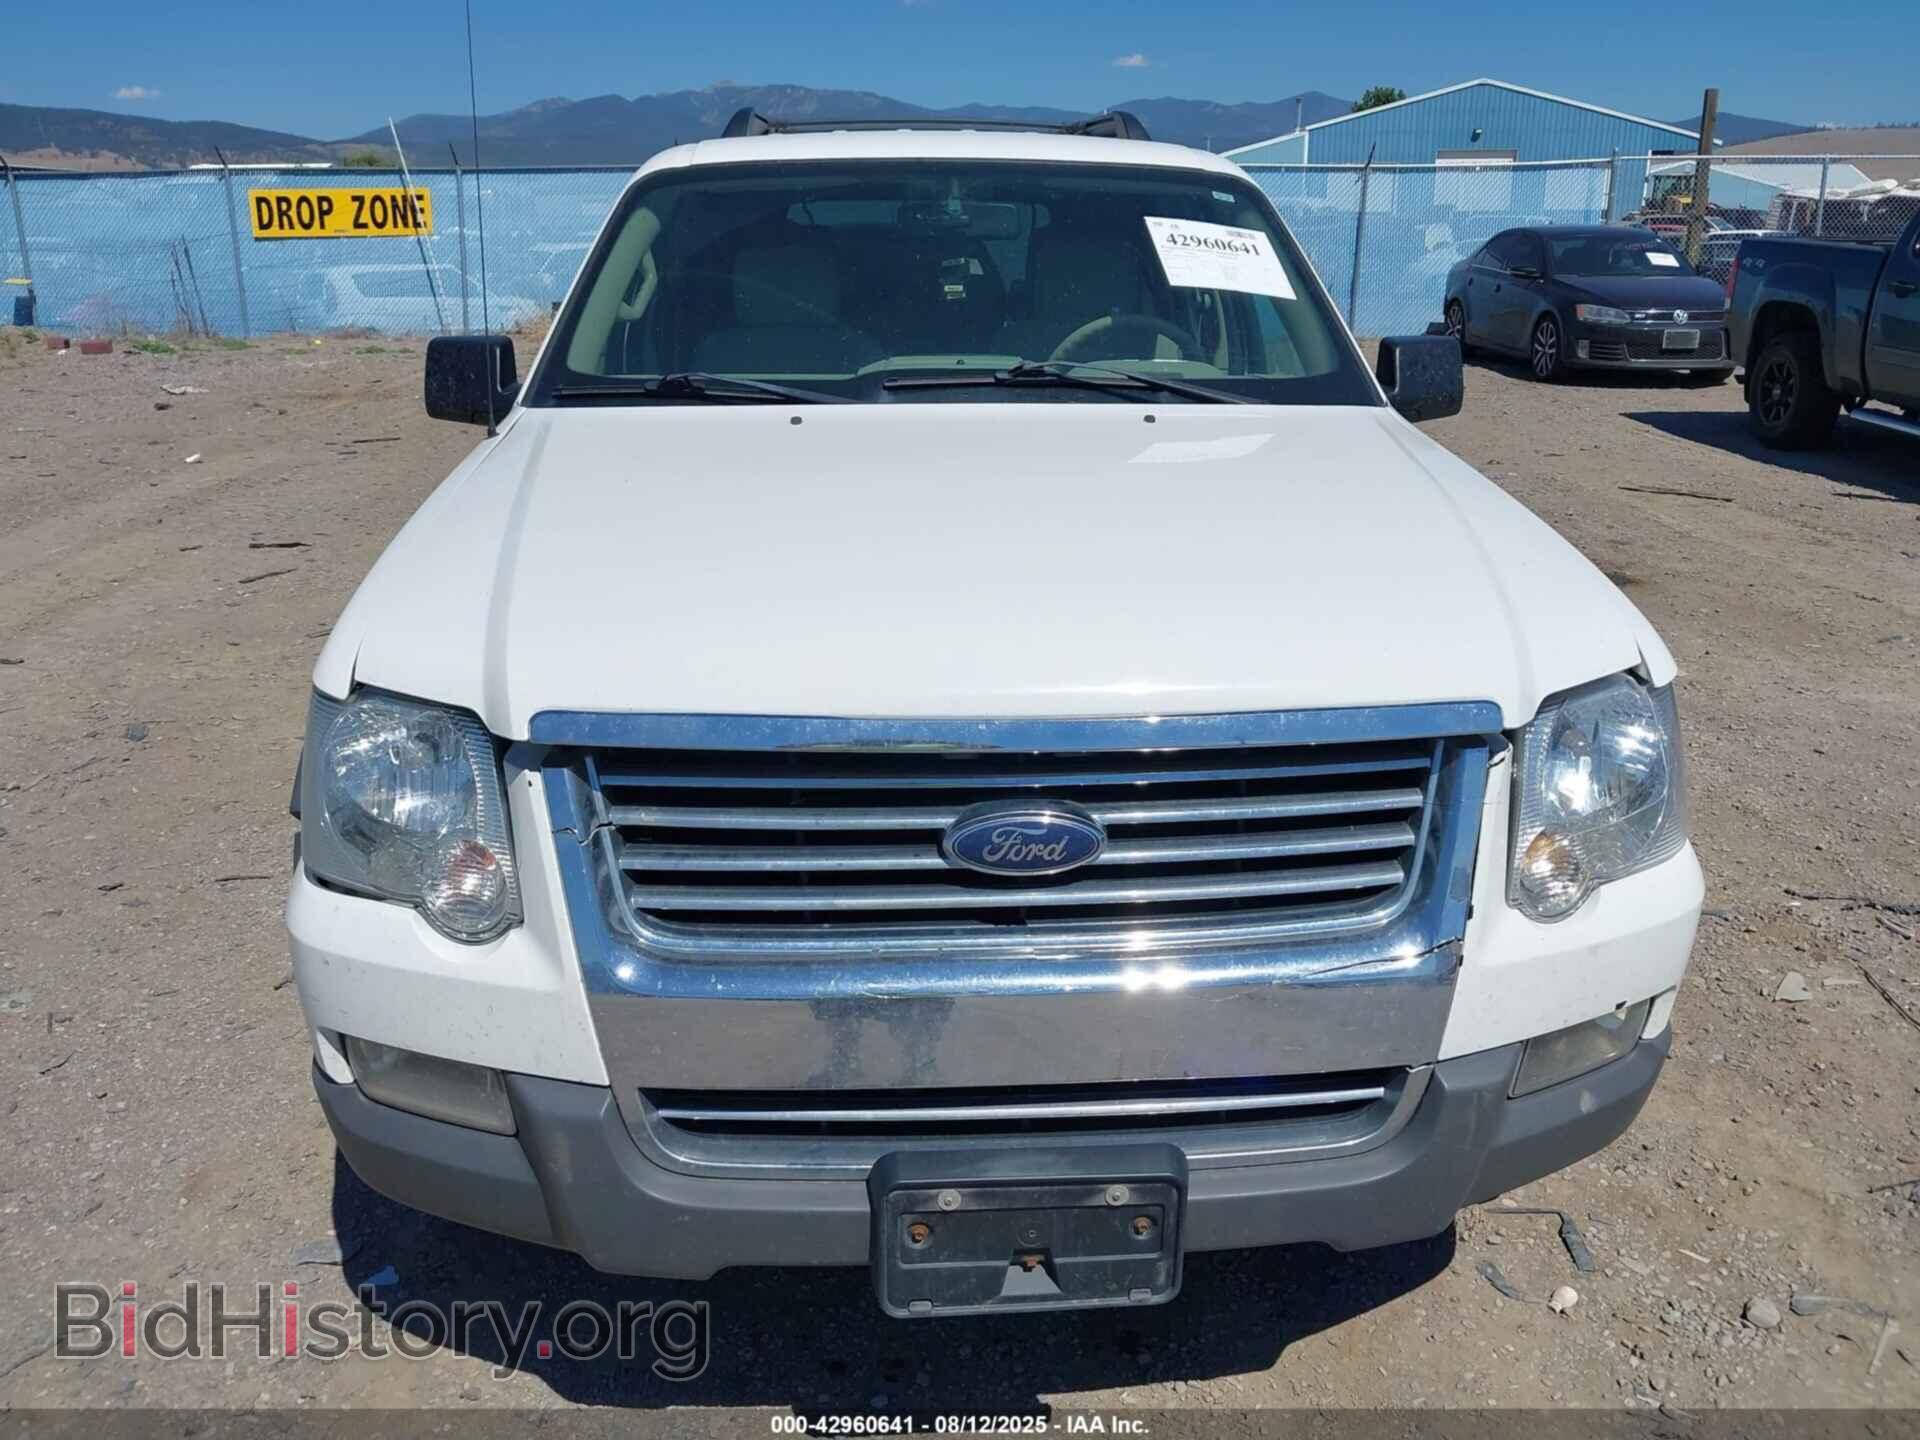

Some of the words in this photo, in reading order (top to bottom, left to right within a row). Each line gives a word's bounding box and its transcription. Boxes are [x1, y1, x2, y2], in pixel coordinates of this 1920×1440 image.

[255, 195, 334, 231] DROP
[350, 194, 428, 230] ZONE
[1166, 233, 1260, 256] 42960641
[982, 826, 1067, 862] Ford
